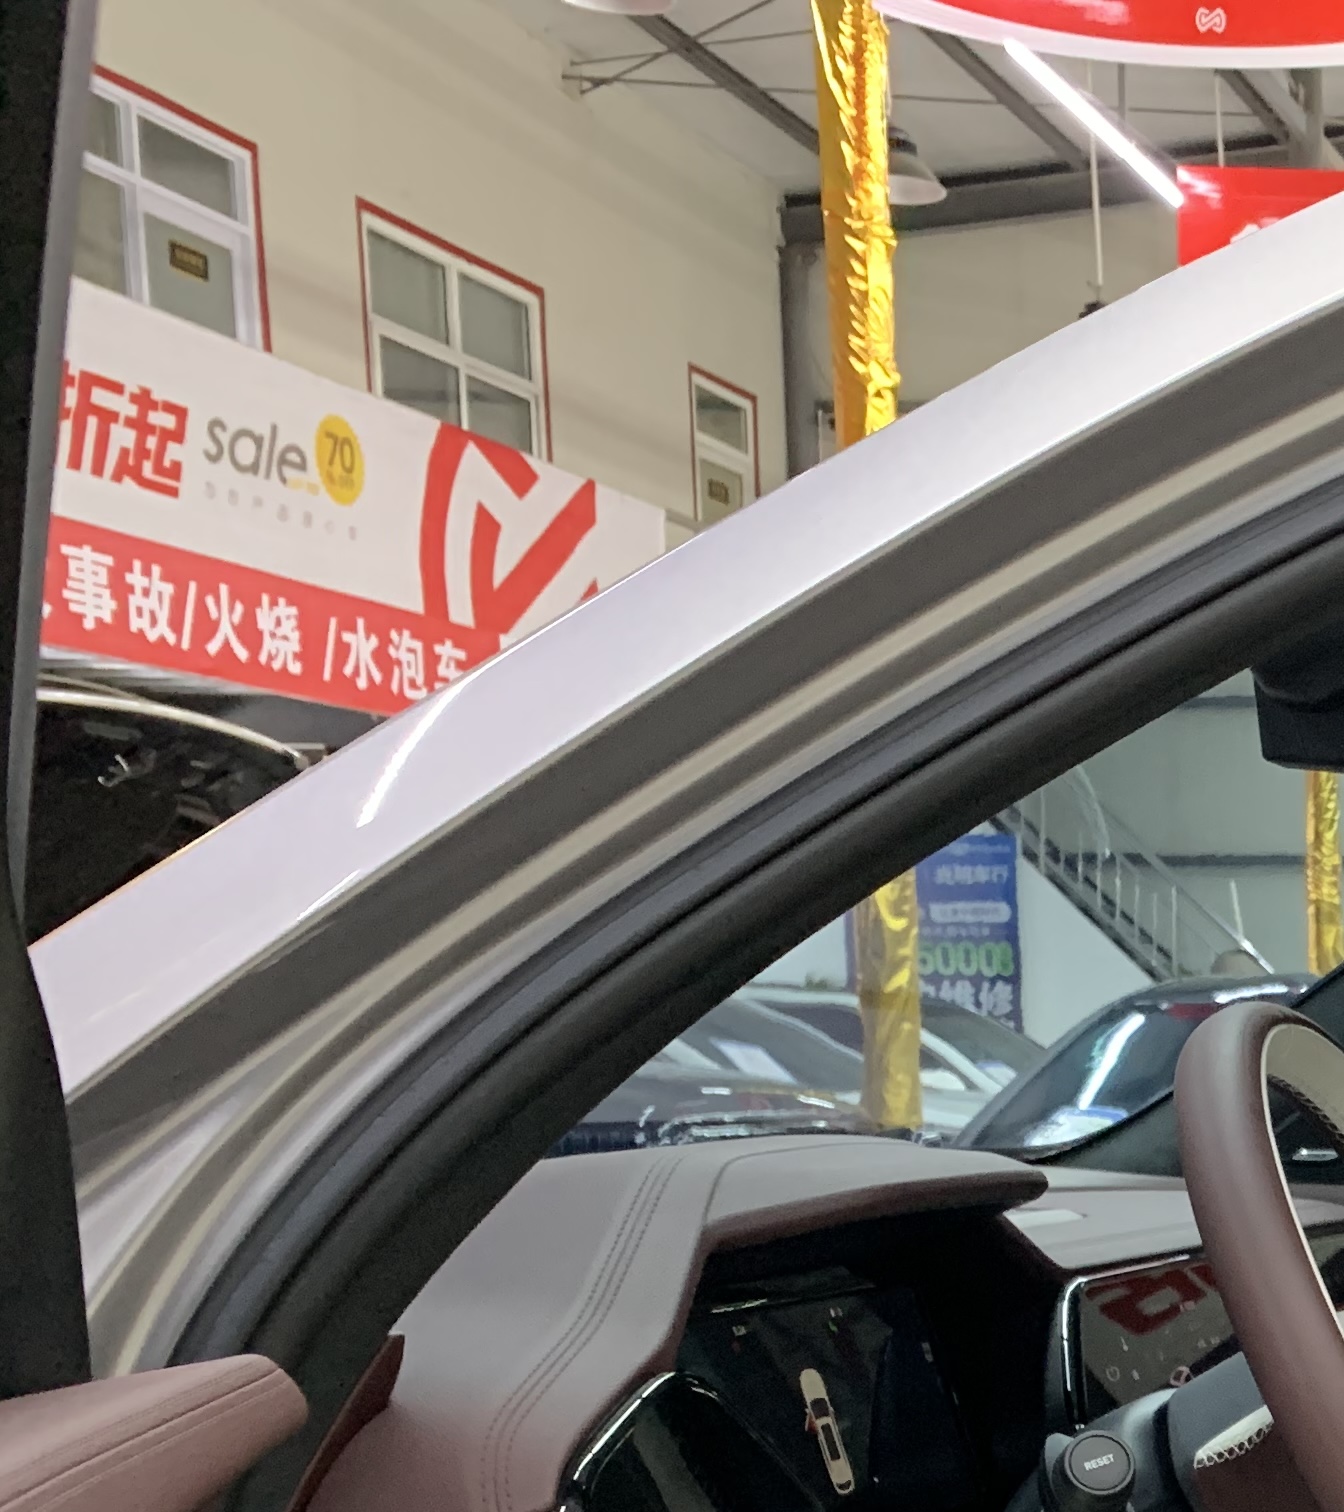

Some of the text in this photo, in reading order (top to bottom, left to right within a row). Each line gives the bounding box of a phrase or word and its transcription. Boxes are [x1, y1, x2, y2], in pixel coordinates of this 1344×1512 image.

[58, 360, 188, 498] 折起
[203, 416, 356, 486] sale 70
[42, 544, 467, 699] 事故/火烧/水泡车
[1084, 1453, 1114, 1471] RESET
